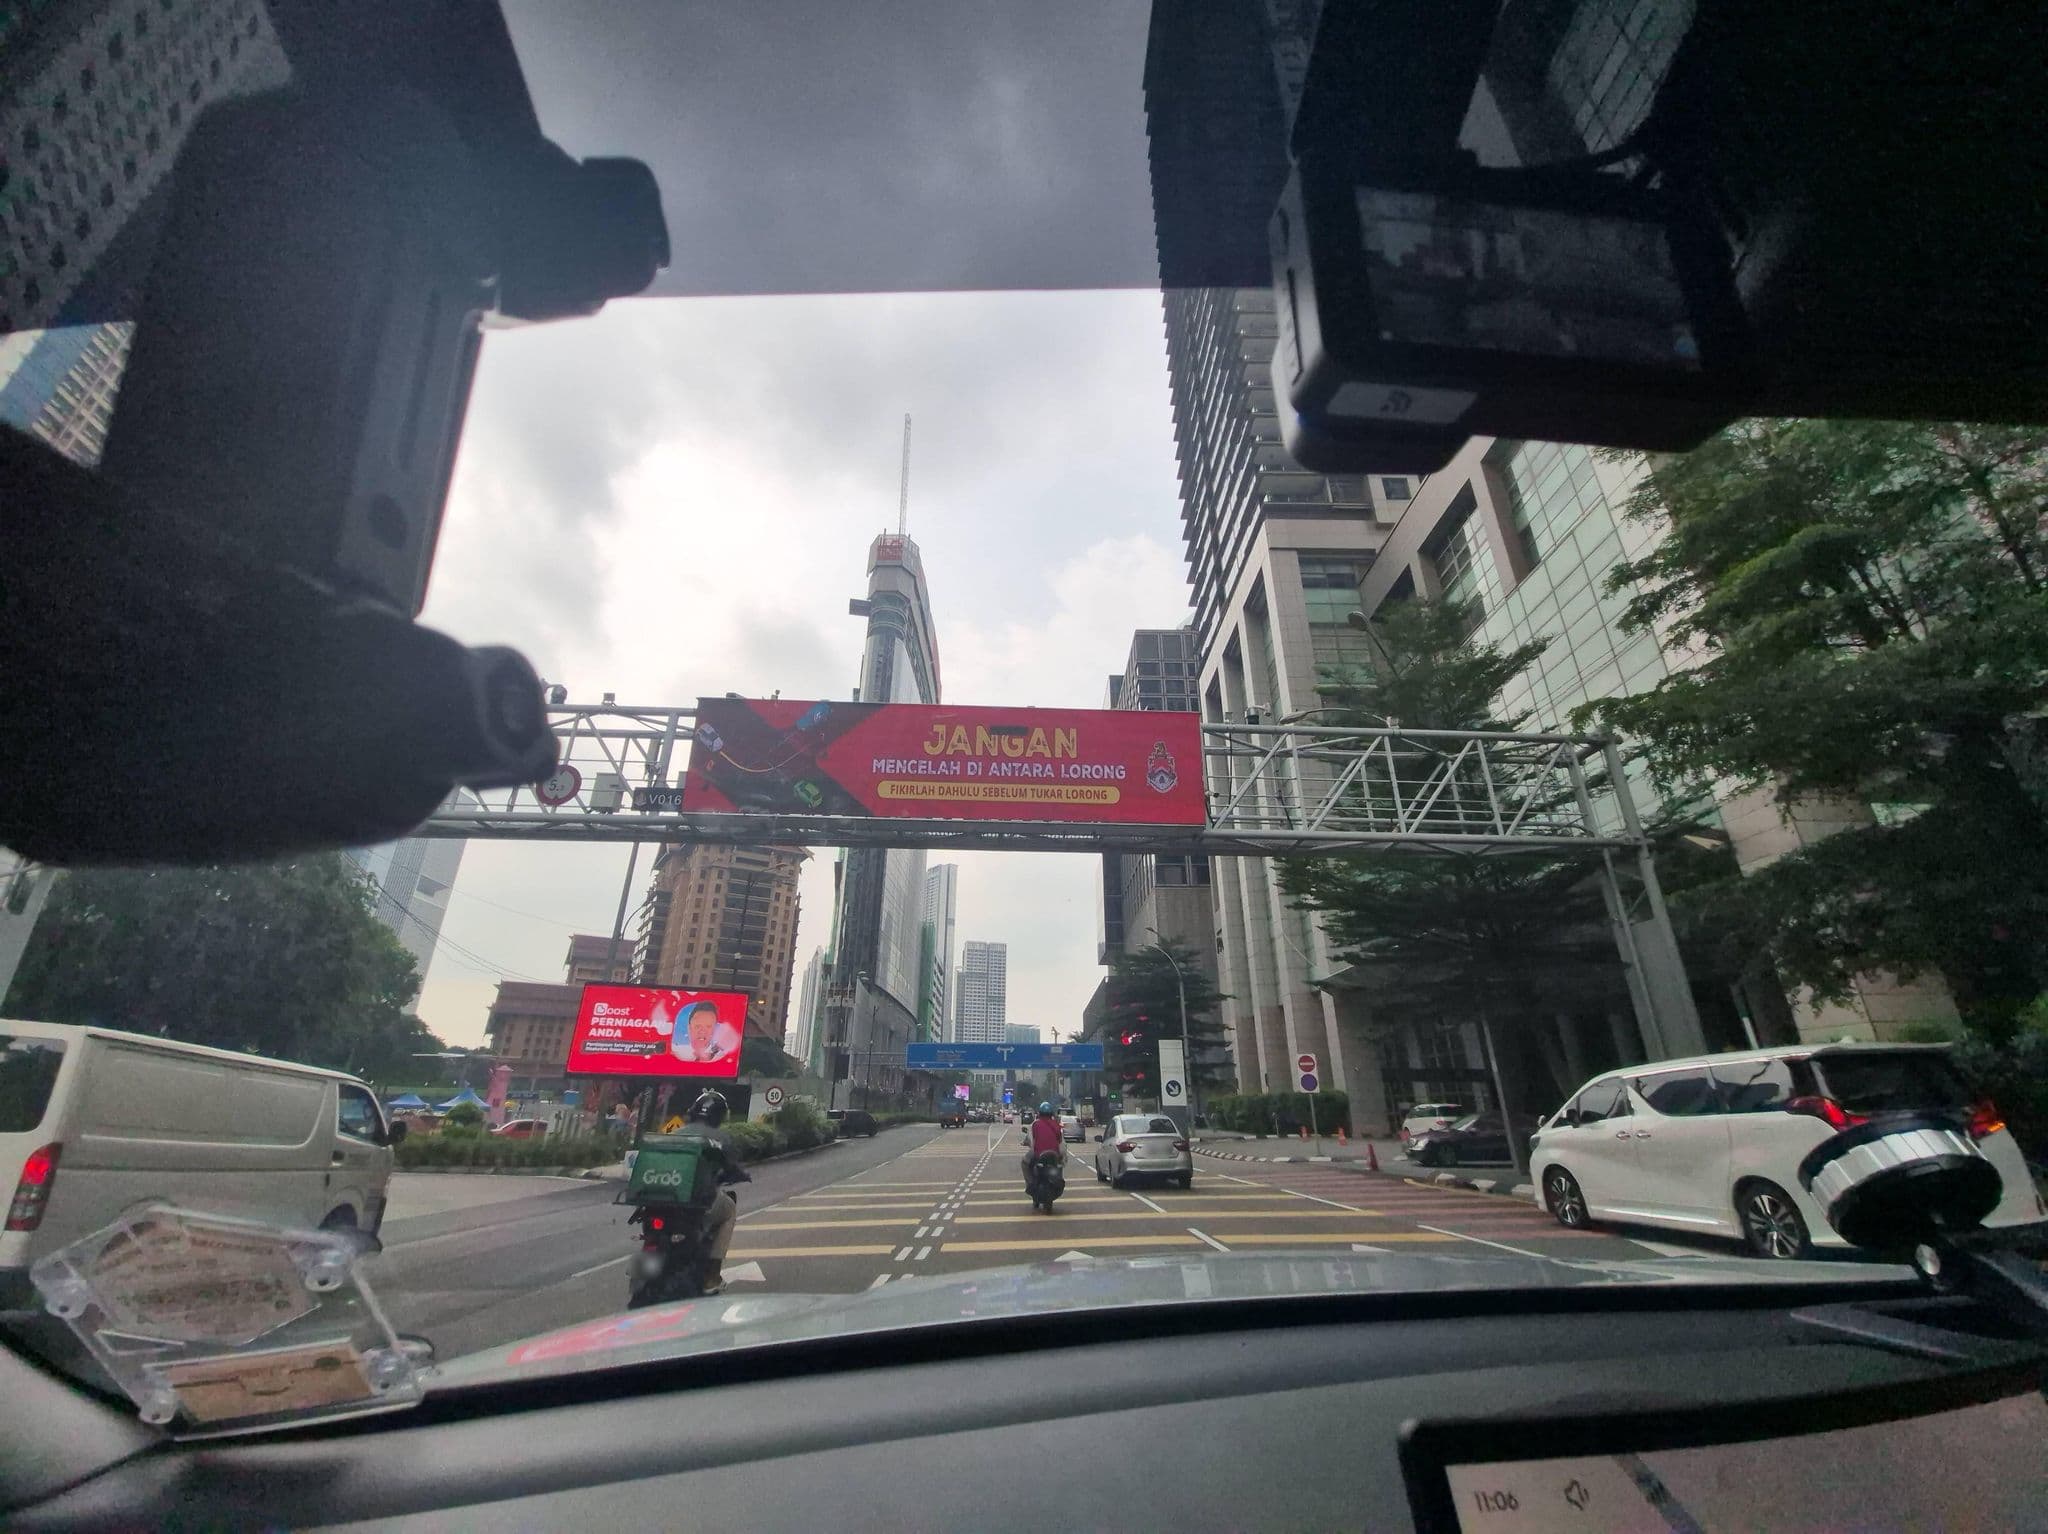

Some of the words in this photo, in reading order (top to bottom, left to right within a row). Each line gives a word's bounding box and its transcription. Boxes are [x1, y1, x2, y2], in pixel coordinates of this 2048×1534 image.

[923, 724, 1077, 758] JANGAN
[872, 758, 961, 775] MENCELAH
[967, 761, 982, 776] DI
[988, 761, 1055, 778] ANTARA
[1061, 763, 1126, 779] LORONG
[649, 794, 682, 806] V016
[890, 784, 935, 796] FIKIRLAH
[938, 785, 980, 797] DAHULU
[982, 787, 1028, 798] SEBELUM
[1031, 788, 1063, 800] TUKAR
[1066, 789, 1107, 800] LORONG
[588, 1028, 622, 1038] ANDA
[770, 1091, 780, 1101] 50
[643, 1169, 682, 1186] Grab
[1474, 1490, 1519, 1512] 11:06
